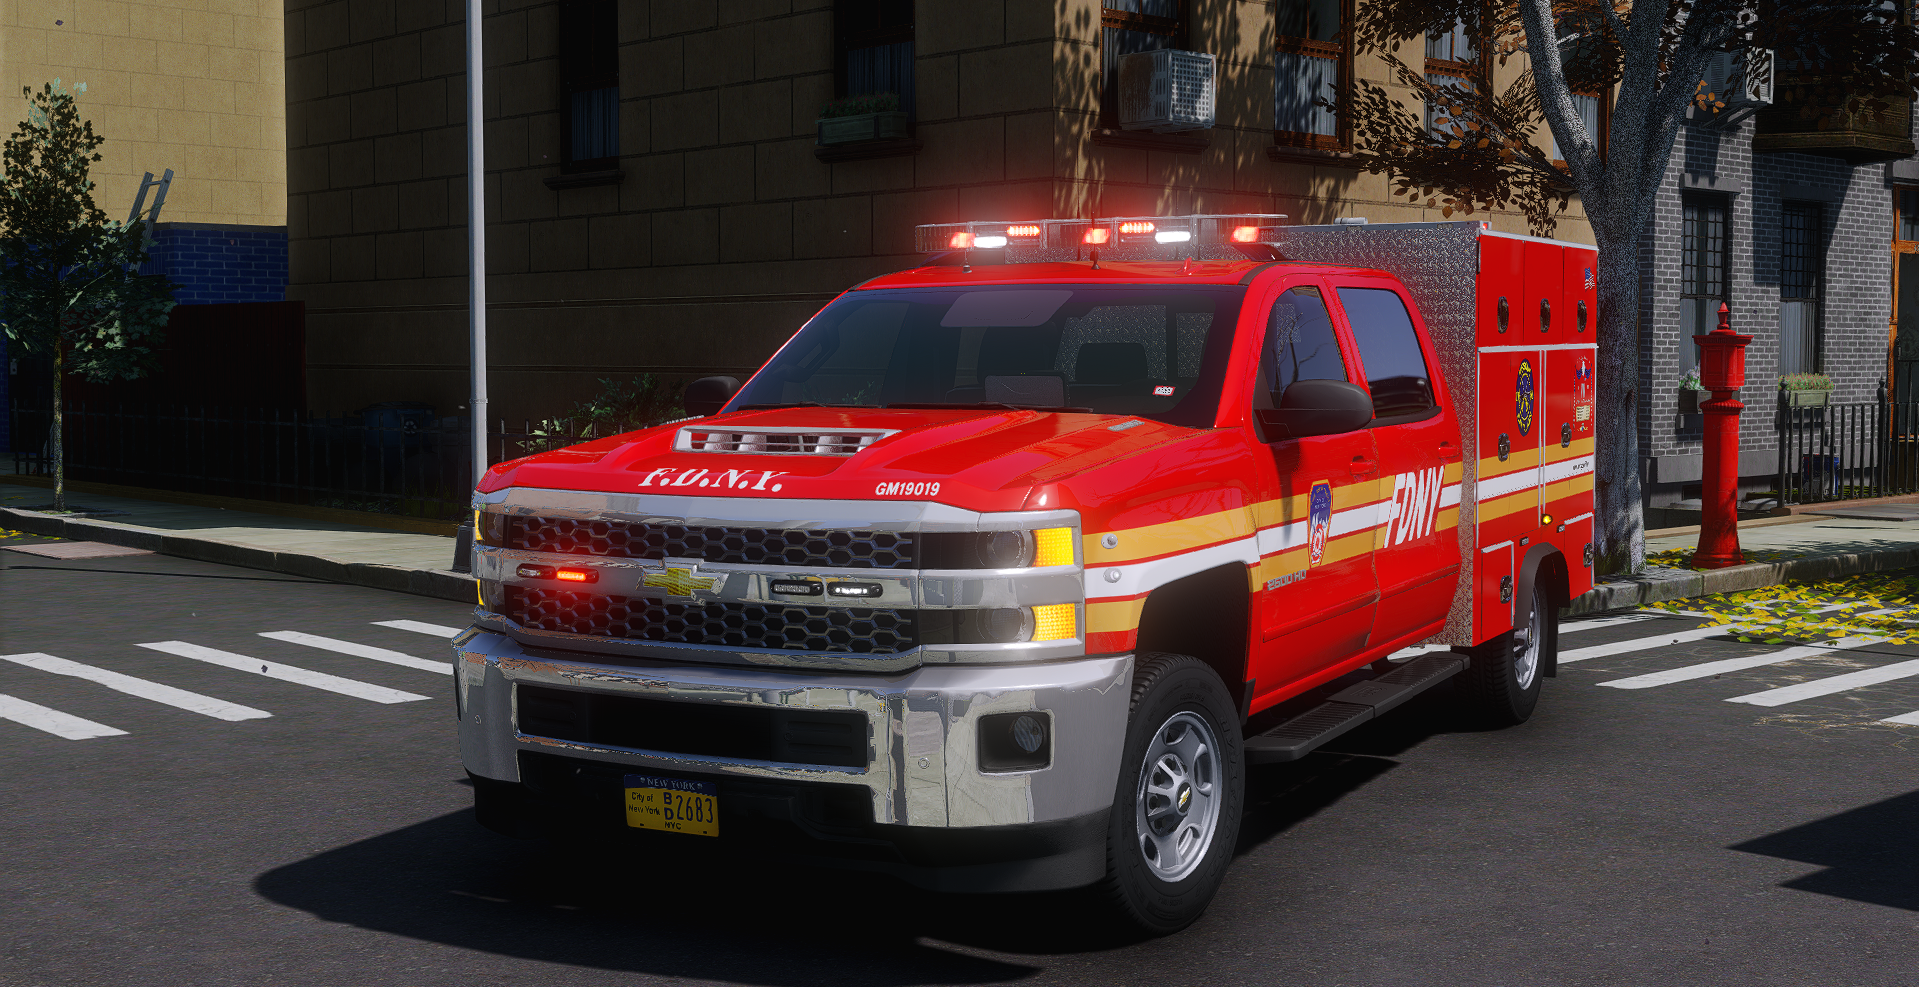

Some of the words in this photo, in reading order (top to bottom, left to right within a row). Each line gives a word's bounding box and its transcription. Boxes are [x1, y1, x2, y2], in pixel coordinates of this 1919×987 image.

[637, 467, 790, 493] F.D.N.Y.
[874, 482, 941, 497] GM19019
[1383, 465, 1445, 549] FDNY
[647, 778, 669, 788] NEW
[671, 780, 696, 791] YORK
[631, 791, 645, 803] City
[646, 794, 654, 803] of
[628, 804, 644, 813] New
[645, 805, 661, 816] York
[675, 795, 714, 824] 2683
[664, 821, 682, 830] NYC
